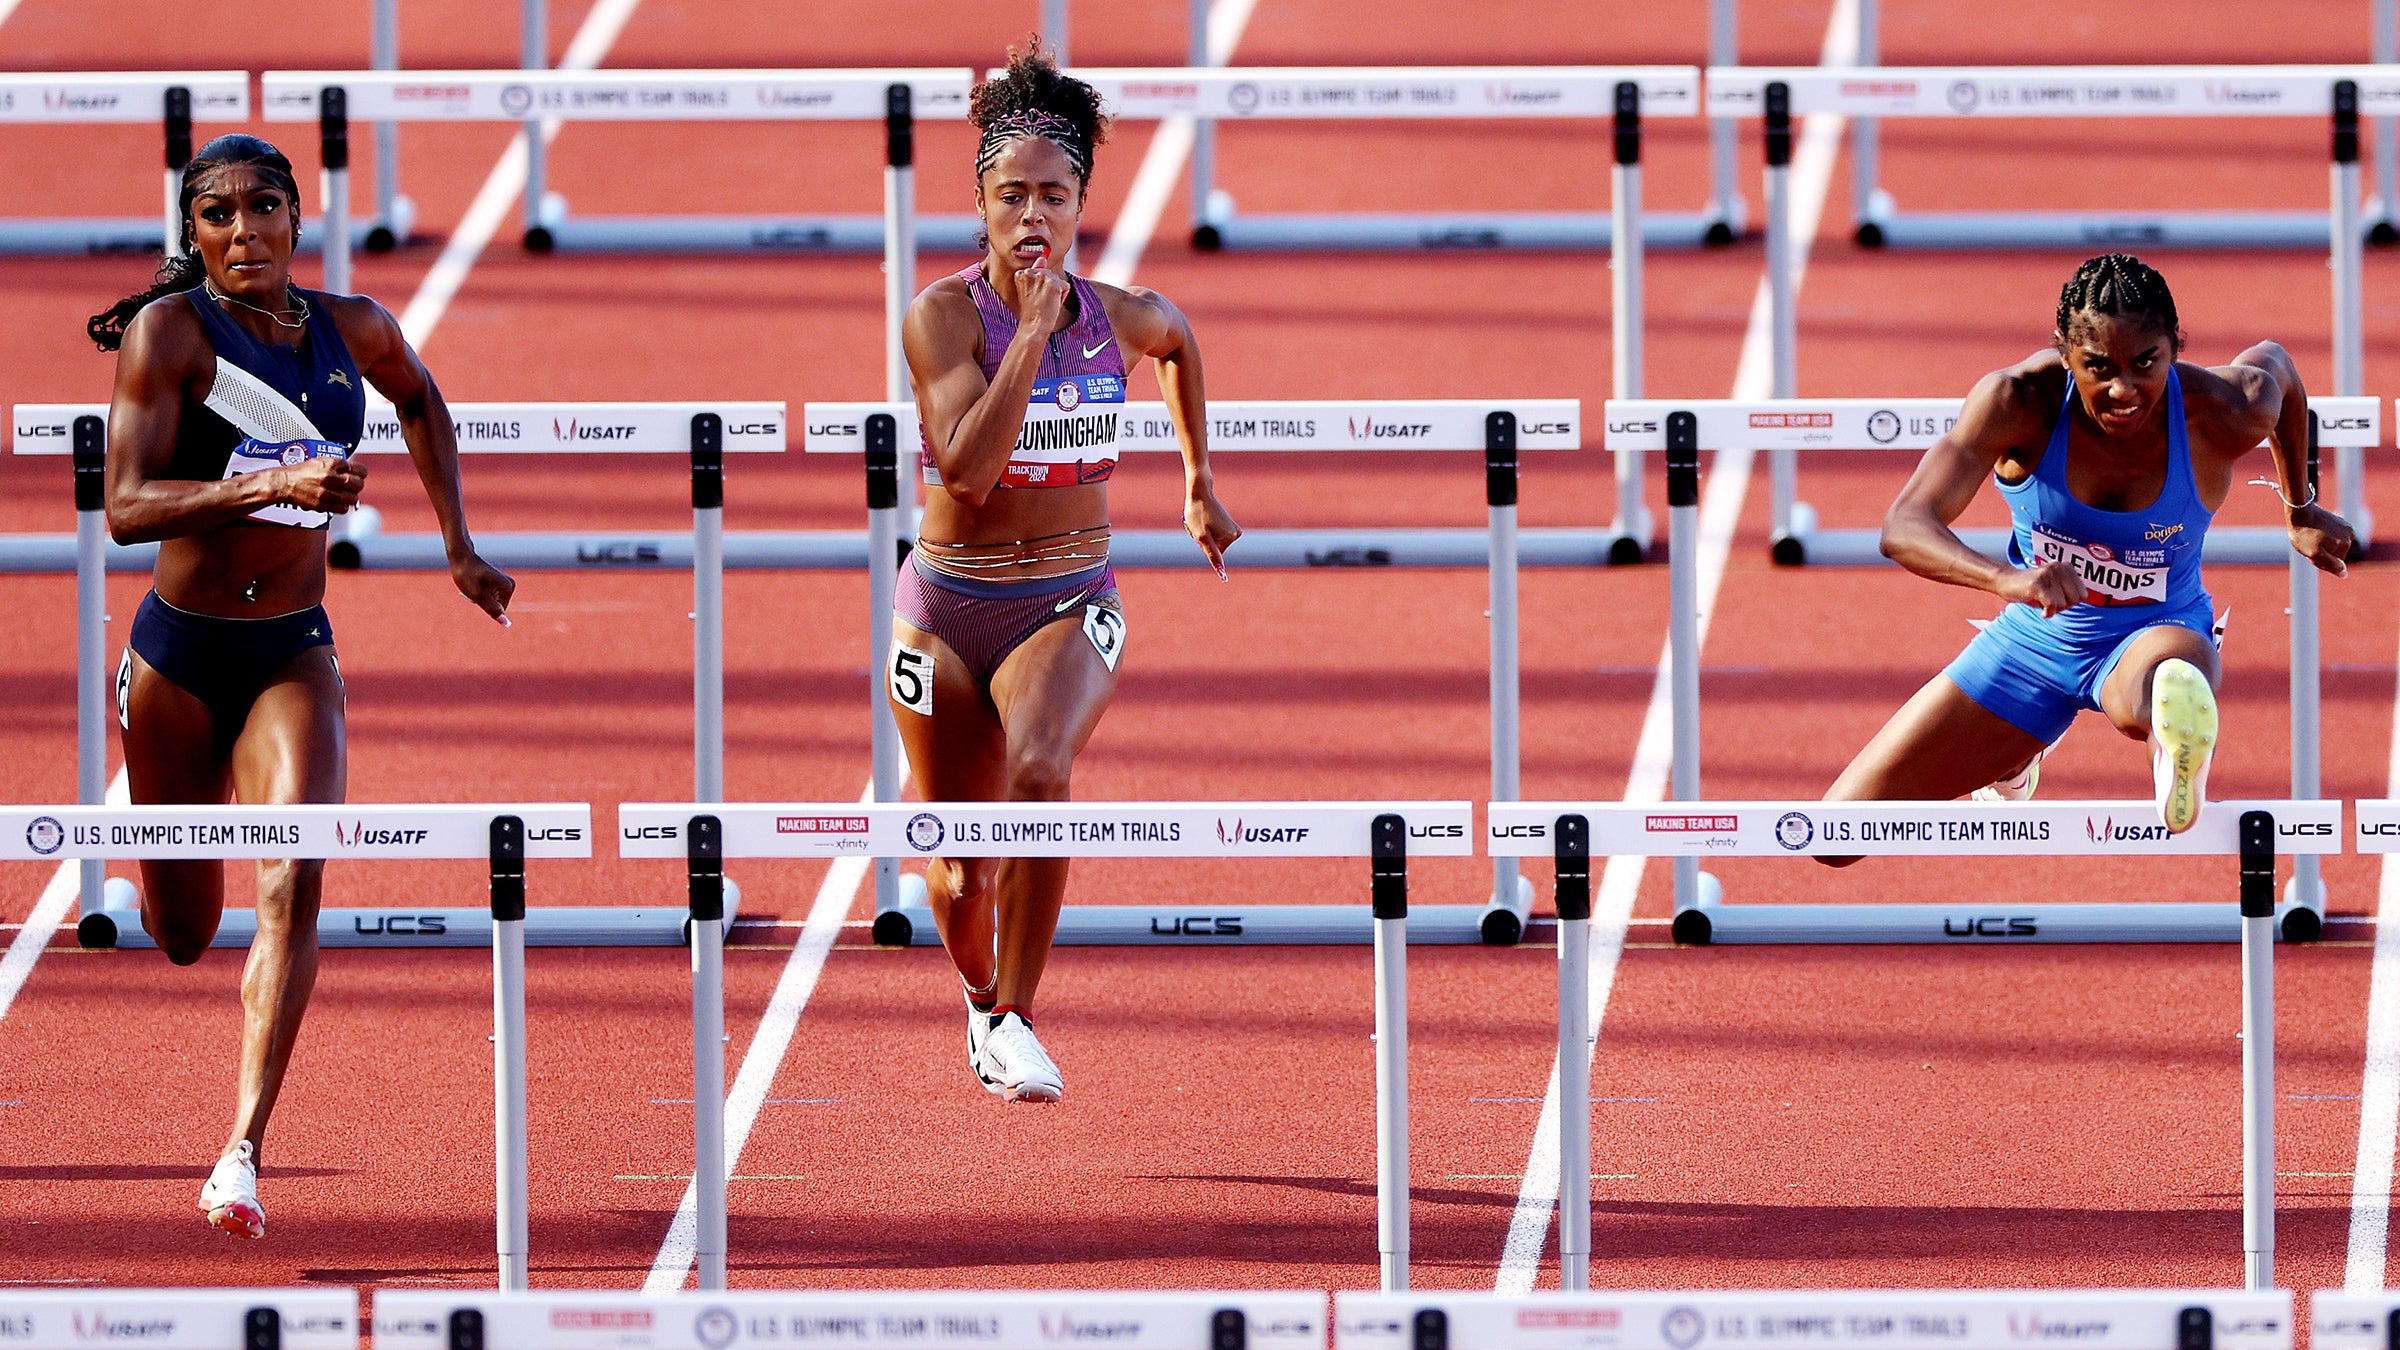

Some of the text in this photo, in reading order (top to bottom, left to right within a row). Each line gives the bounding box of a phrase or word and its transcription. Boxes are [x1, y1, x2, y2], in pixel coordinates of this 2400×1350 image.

[1031, 387, 1049, 396] SATF
[729, 424, 776, 435] UCS
[809, 425, 857, 436] UCS
[1215, 420, 1255, 438] TEAM
[1262, 420, 1315, 438] TRIALS
[1522, 423, 1570, 434] UCS
[1609, 422, 1658, 433] UCS
[1910, 418, 1938, 436] U.S.
[2322, 419, 2370, 430] UCS
[18, 426, 66, 437] UCS
[467, 422, 520, 440] TRIALS
[578, 426, 636, 440] USATF
[1374, 425, 1432, 438] USATF
[1008, 465, 1049, 475] TRACKTOWN
[1028, 473, 1046, 482] 2024
[2144, 523, 2184, 541] Doritos
[577, 543, 660, 562] UCS
[1090, 608, 1122, 655] 5
[894, 649, 923, 705] 5
[779, 819, 866, 831] MAKING TEAM USA
[1648, 818, 1735, 830] MAKING TEAM USA
[2279, 824, 2332, 836] UCS
[2361, 823, 2400, 836] UC
[75, 826, 105, 844] U.S.
[112, 826, 182, 845] OLYMPIC
[189, 826, 234, 844] TEAM
[240, 825, 299, 844] TRIALS
[528, 828, 582, 840] UCS
[624, 827, 677, 839] UCS
[955, 823, 985, 842] U.S.
[992, 823, 1063, 842] OLYMPIC
[1069, 823, 1114, 841] TEAM
[1121, 823, 1180, 841] TRIALS
[1245, 828, 1309, 843] USATF
[1410, 826, 1463, 837] UCS
[1492, 826, 1545, 838] UCS
[1824, 822, 1854, 840] U.S.
[1862, 822, 1932, 840] OLYMPIC
[1938, 822, 1984, 840] TEAM
[1990, 821, 2050, 840] TRIALS
[364, 830, 428, 844] USATF
[1704, 837, 1738, 848] xfinity
[836, 839, 869, 849] xfinity
[355, 916, 446, 935] UCS
[1151, 917, 1243, 935] UCS
[1944, 917, 2037, 936] UCS
